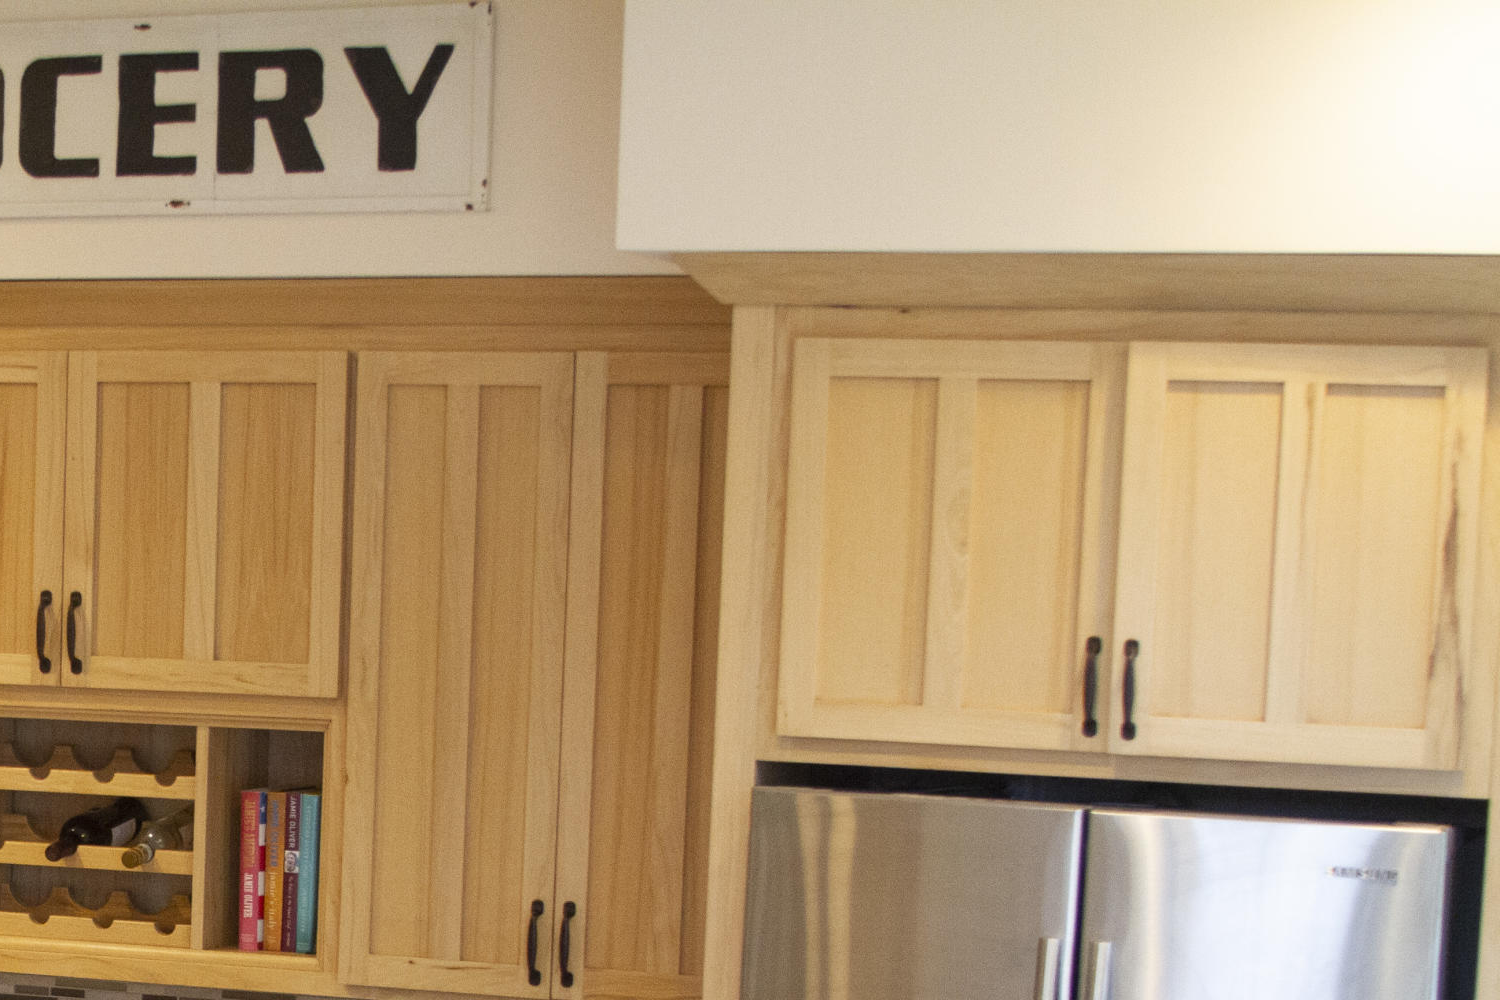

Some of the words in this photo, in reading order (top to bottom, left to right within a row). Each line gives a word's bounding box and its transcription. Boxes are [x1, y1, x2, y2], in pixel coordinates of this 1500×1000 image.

[244, 873, 253, 893] JAMIE
[243, 895, 253, 918] OLIVER
[267, 908, 278, 929] italy
